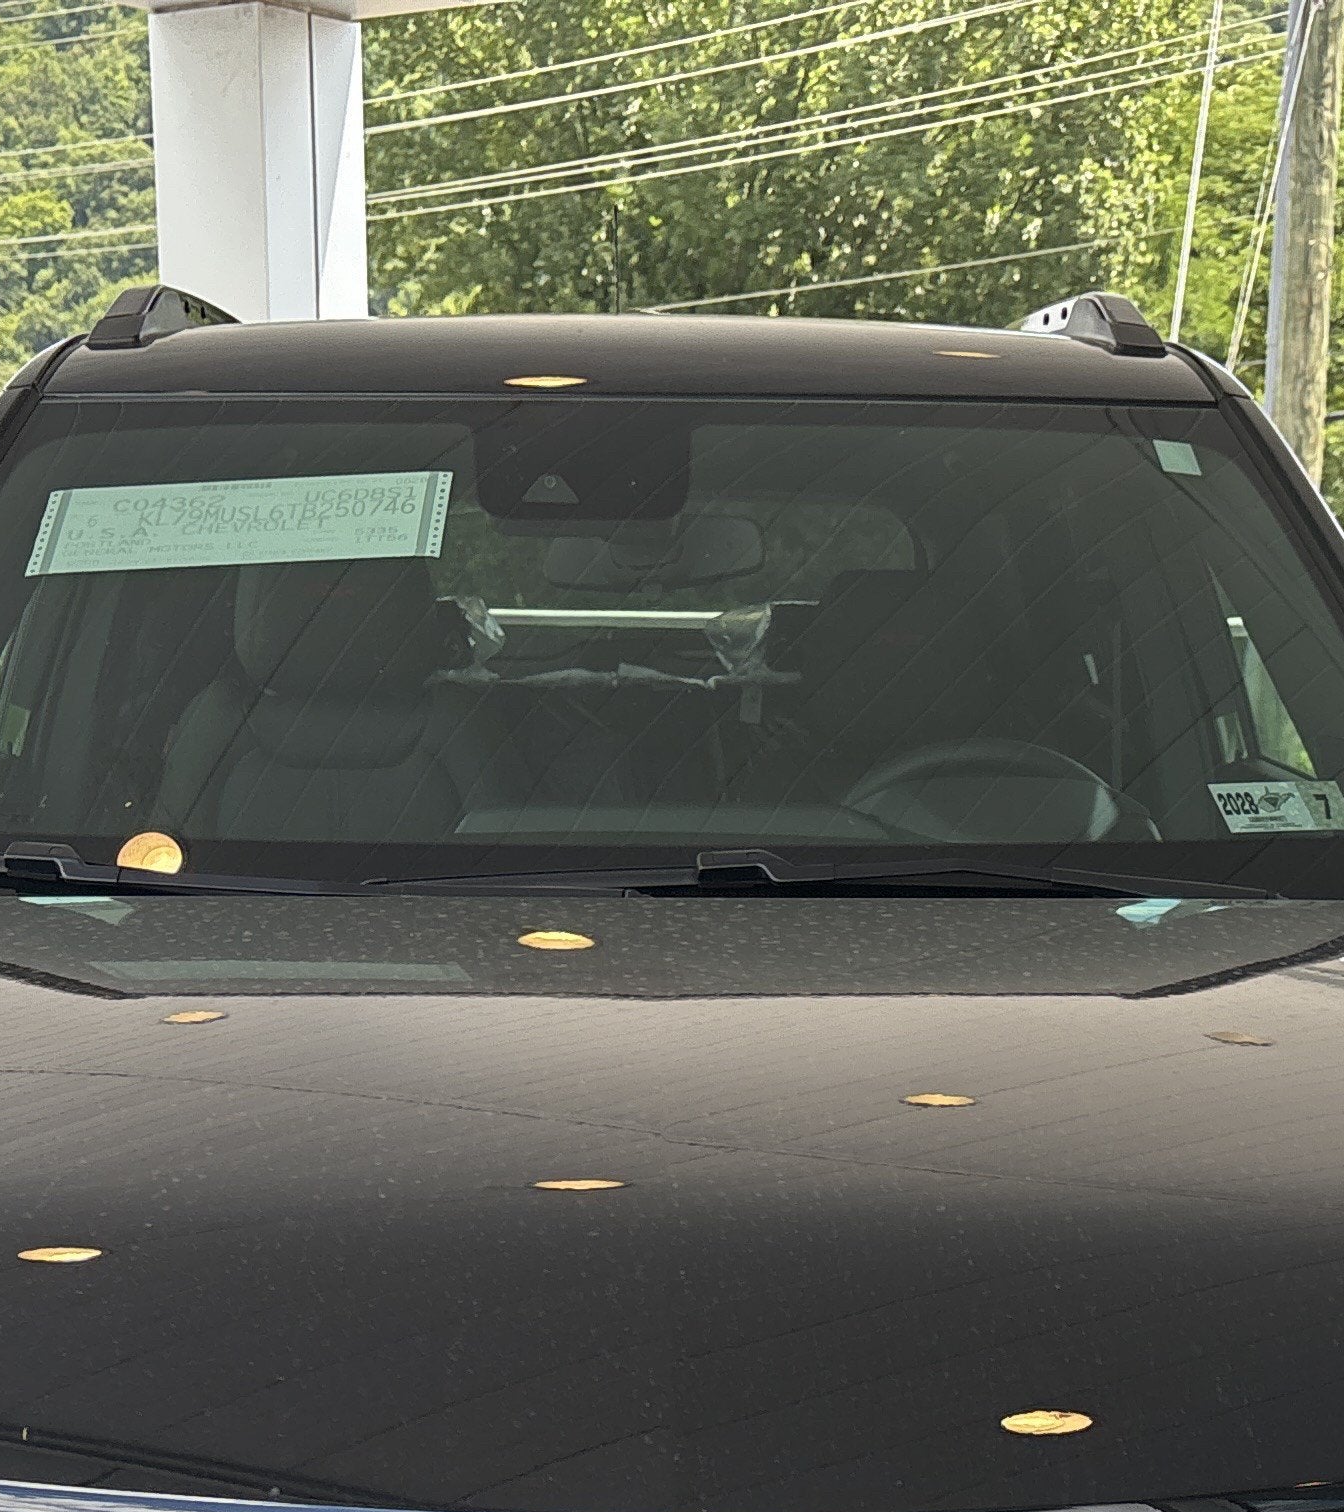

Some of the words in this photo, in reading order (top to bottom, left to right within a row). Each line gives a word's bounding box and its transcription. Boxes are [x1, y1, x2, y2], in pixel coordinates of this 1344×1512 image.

[182, 516, 331, 536] CHEVROLET
[1217, 791, 1260, 816] 2028
[1312, 793, 1332, 820] 7
